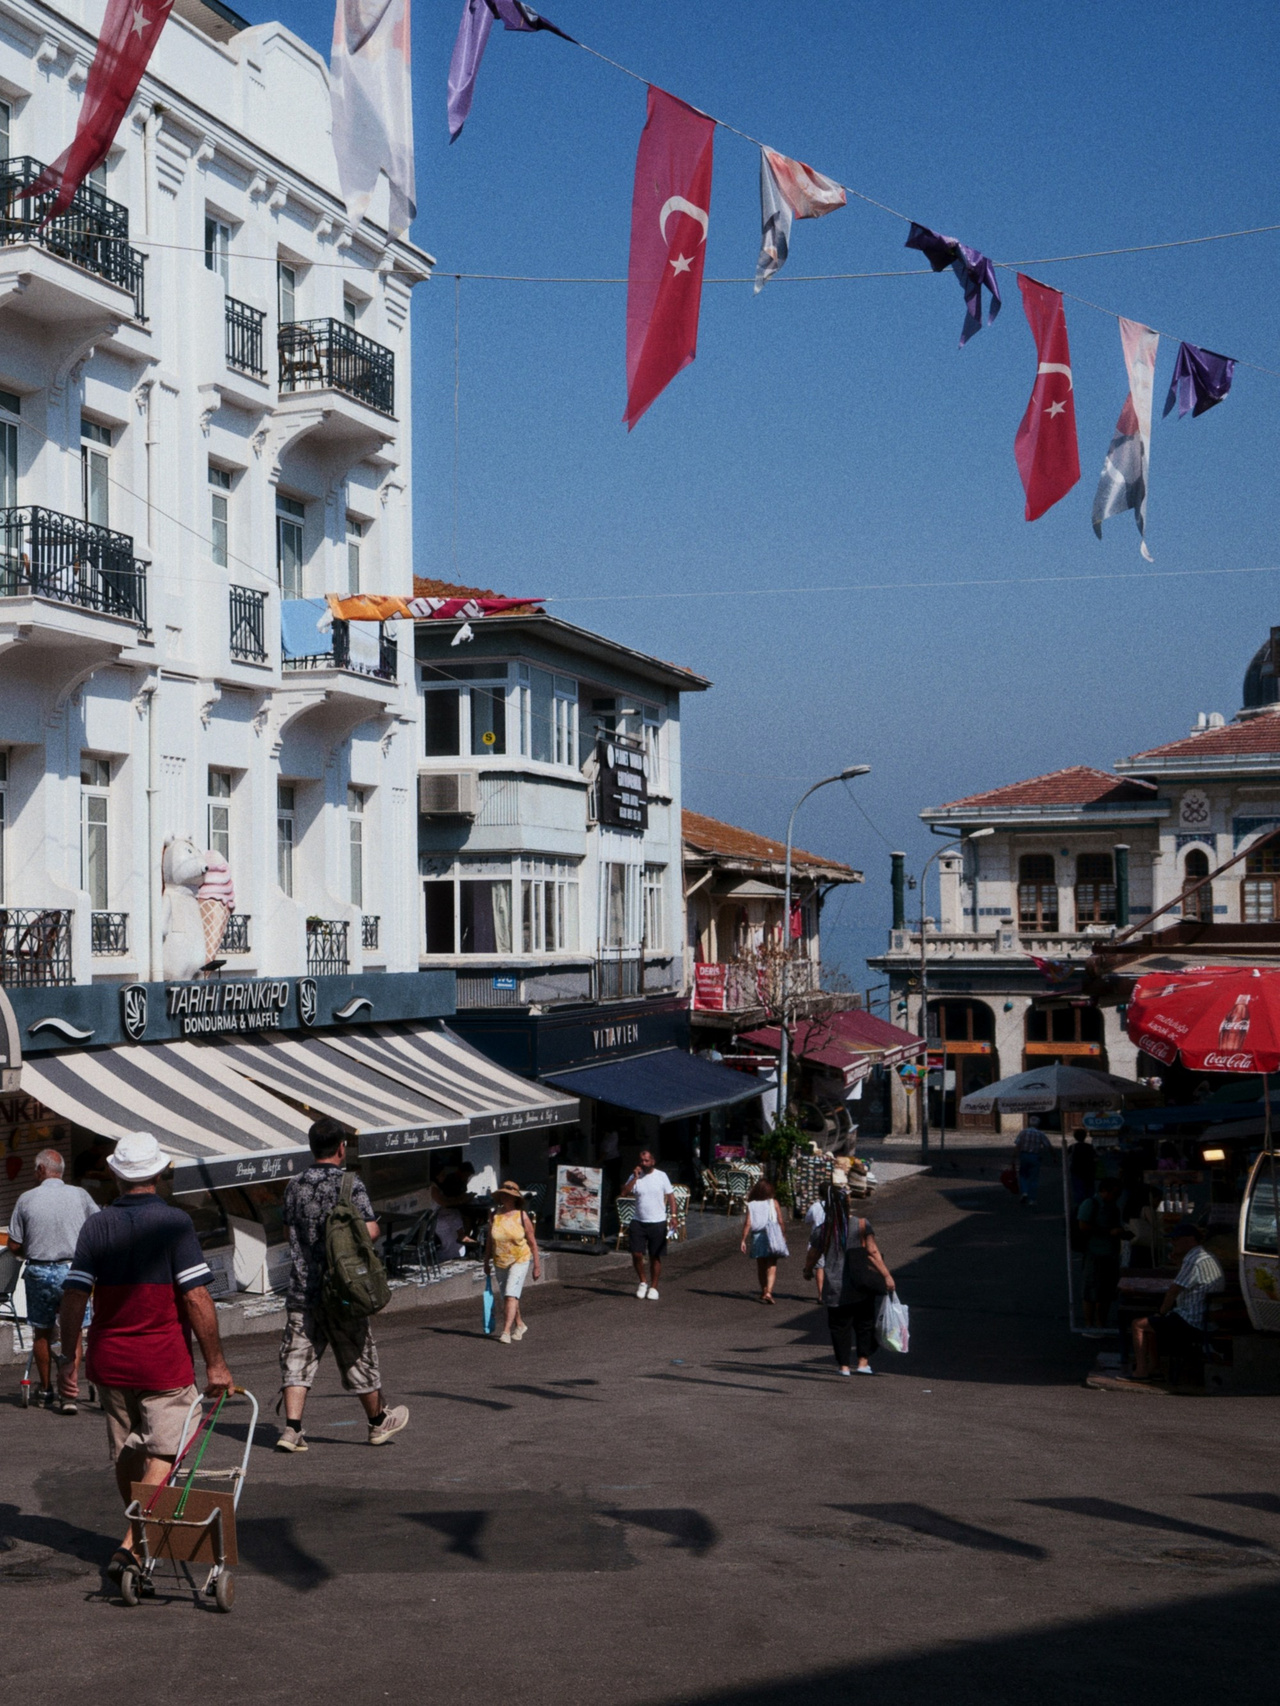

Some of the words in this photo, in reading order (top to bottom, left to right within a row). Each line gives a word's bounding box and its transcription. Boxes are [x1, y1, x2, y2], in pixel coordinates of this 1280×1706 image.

[185, 1015, 238, 1034] DONDURMA
[240, 1015, 246, 1029] &
[248, 1012, 279, 1028] WAFFLE
[1203, 1052, 1254, 1068] Coca-Cola
